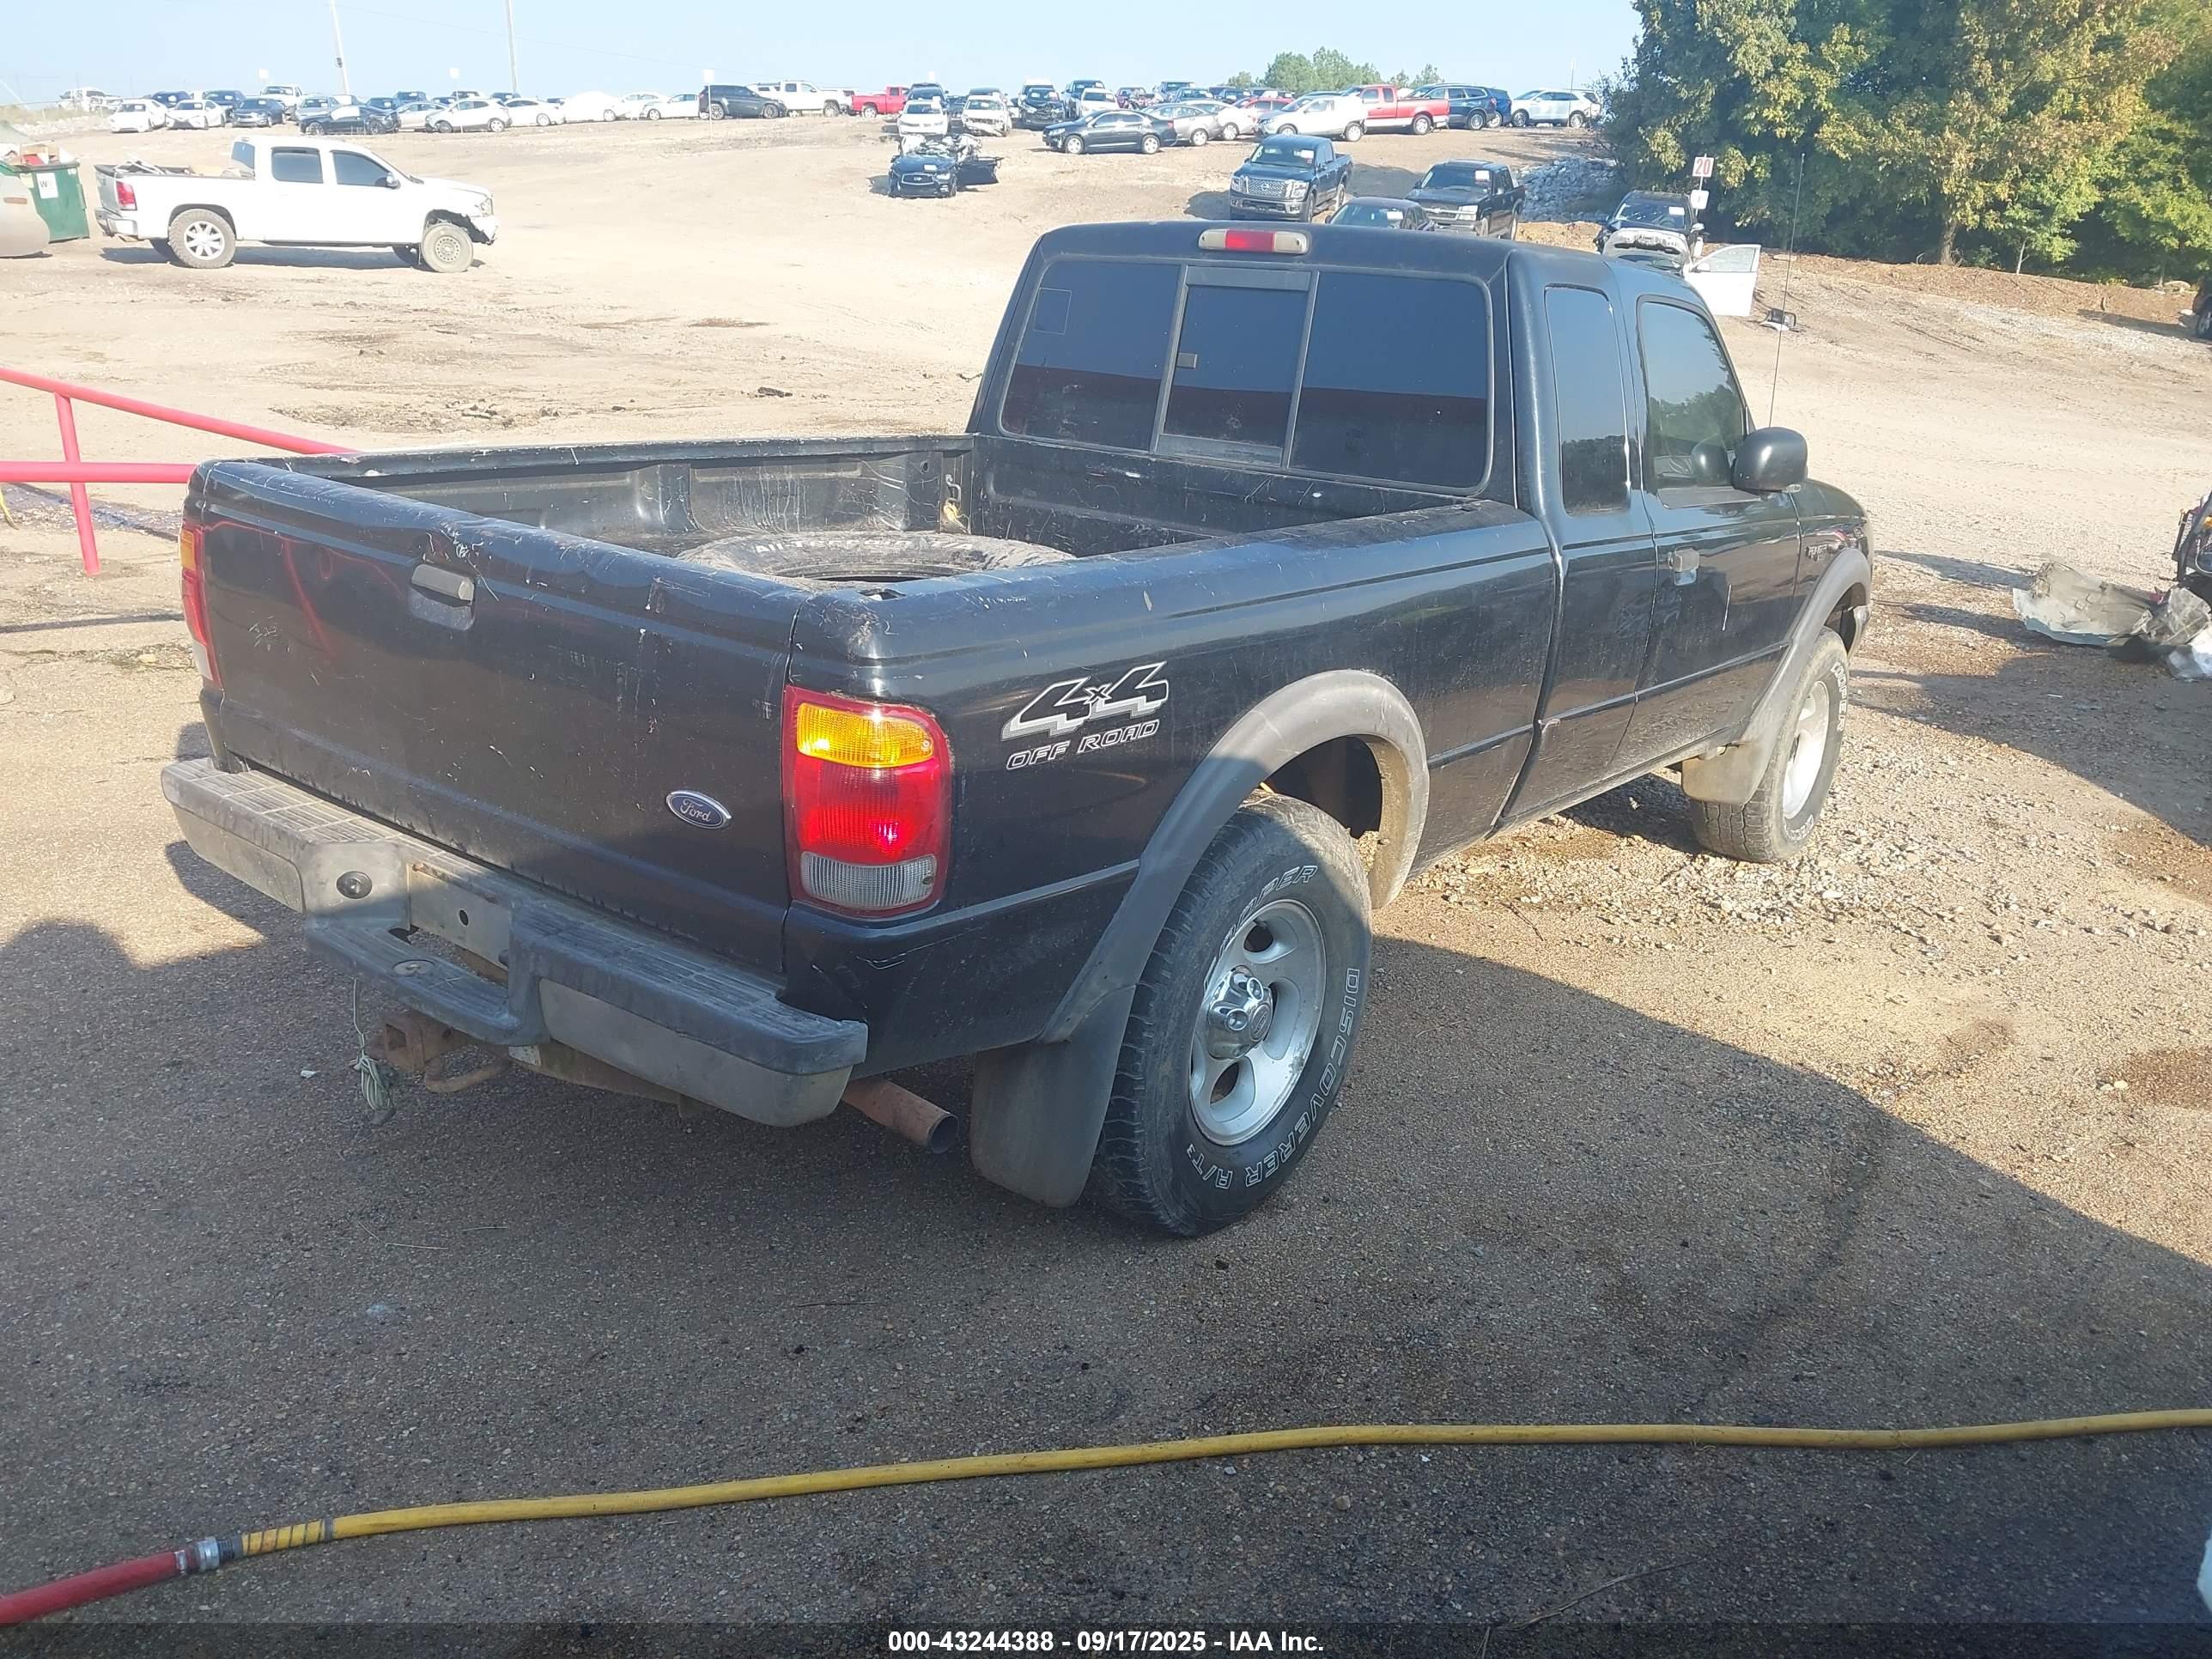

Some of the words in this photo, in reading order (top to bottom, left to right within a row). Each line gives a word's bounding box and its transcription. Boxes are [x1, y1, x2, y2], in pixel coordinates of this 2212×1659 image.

[1695, 158, 1711, 175] 20
[1006, 740, 1071, 770] OFF
[1077, 719, 1160, 754] ROAD
[679, 798, 712, 823] Ford
[1244, 968, 1360, 1188] DISCOVERER
